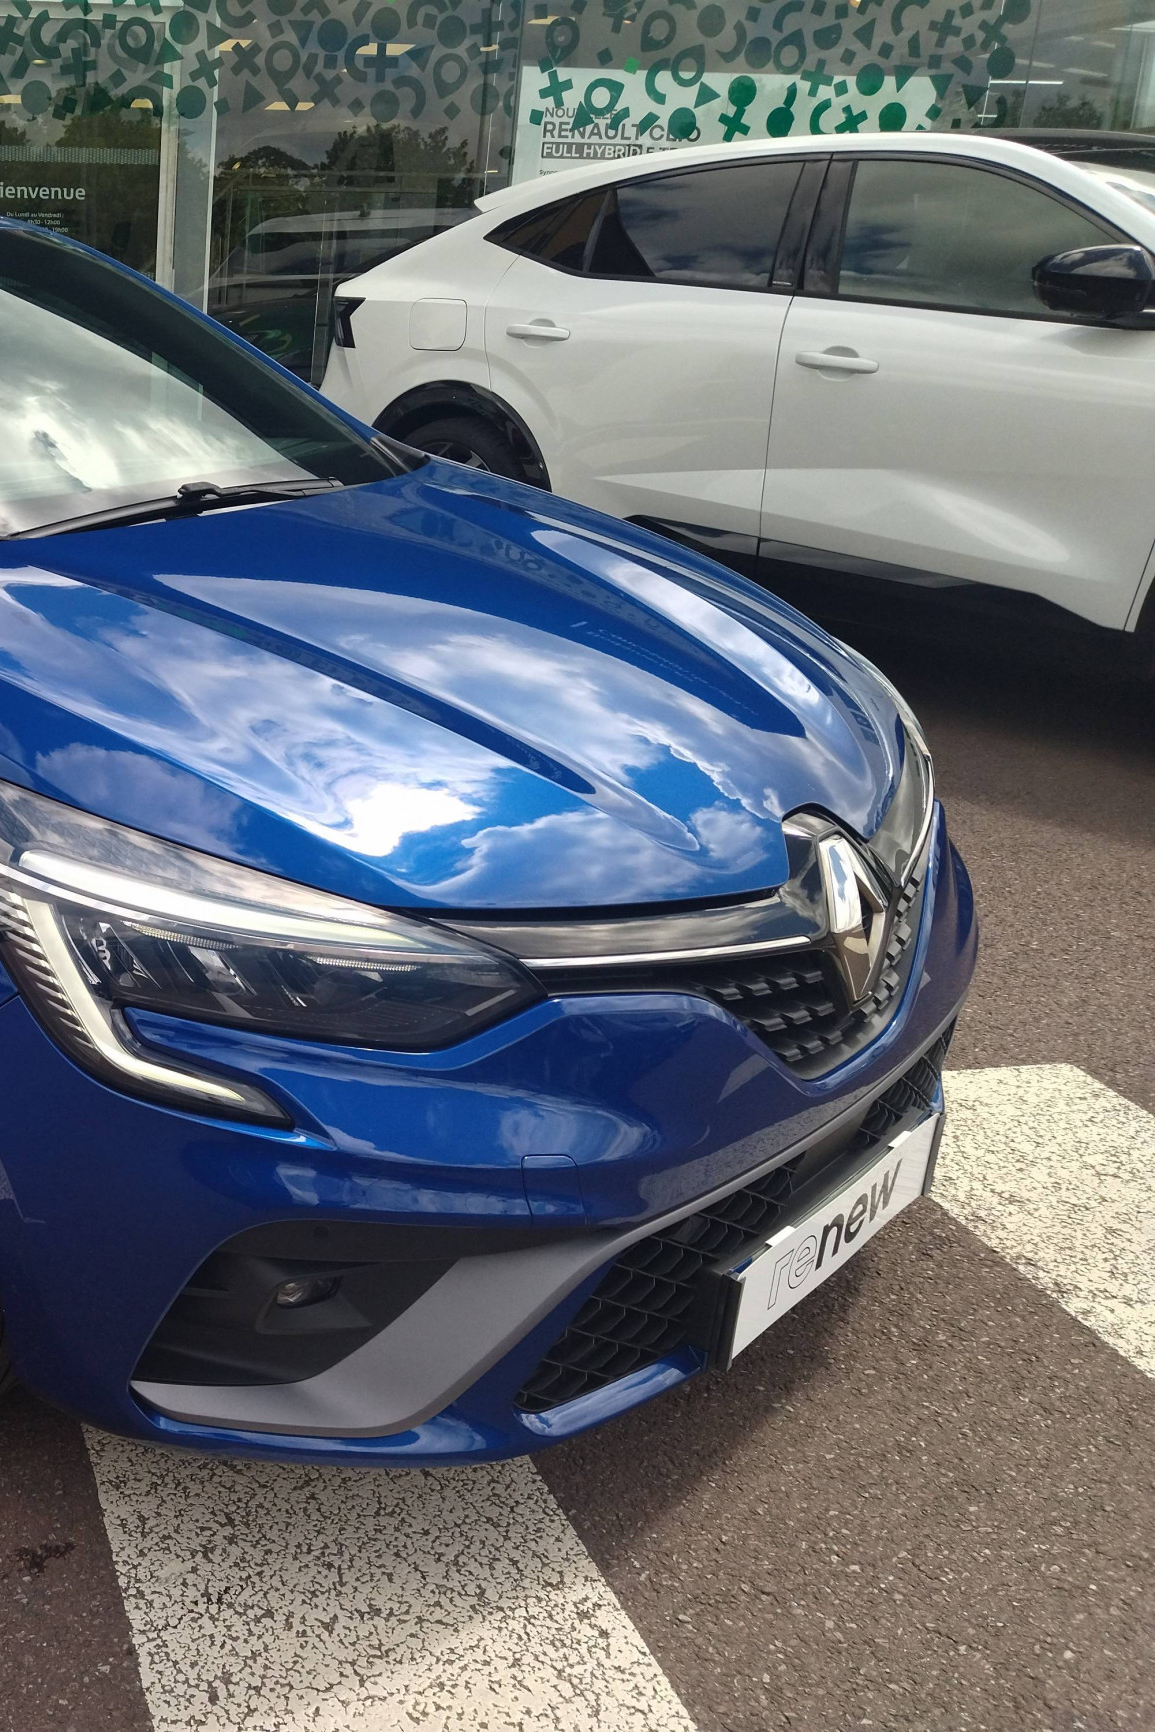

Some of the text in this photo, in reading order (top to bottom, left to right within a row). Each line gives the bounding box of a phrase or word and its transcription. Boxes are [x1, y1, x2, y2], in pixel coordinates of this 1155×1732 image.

[543, 121, 701, 142] RENAULT CLO
[543, 143, 580, 158] FULL
[583, 145, 641, 159] HYBRID
[767, 1158, 902, 1310] renew
